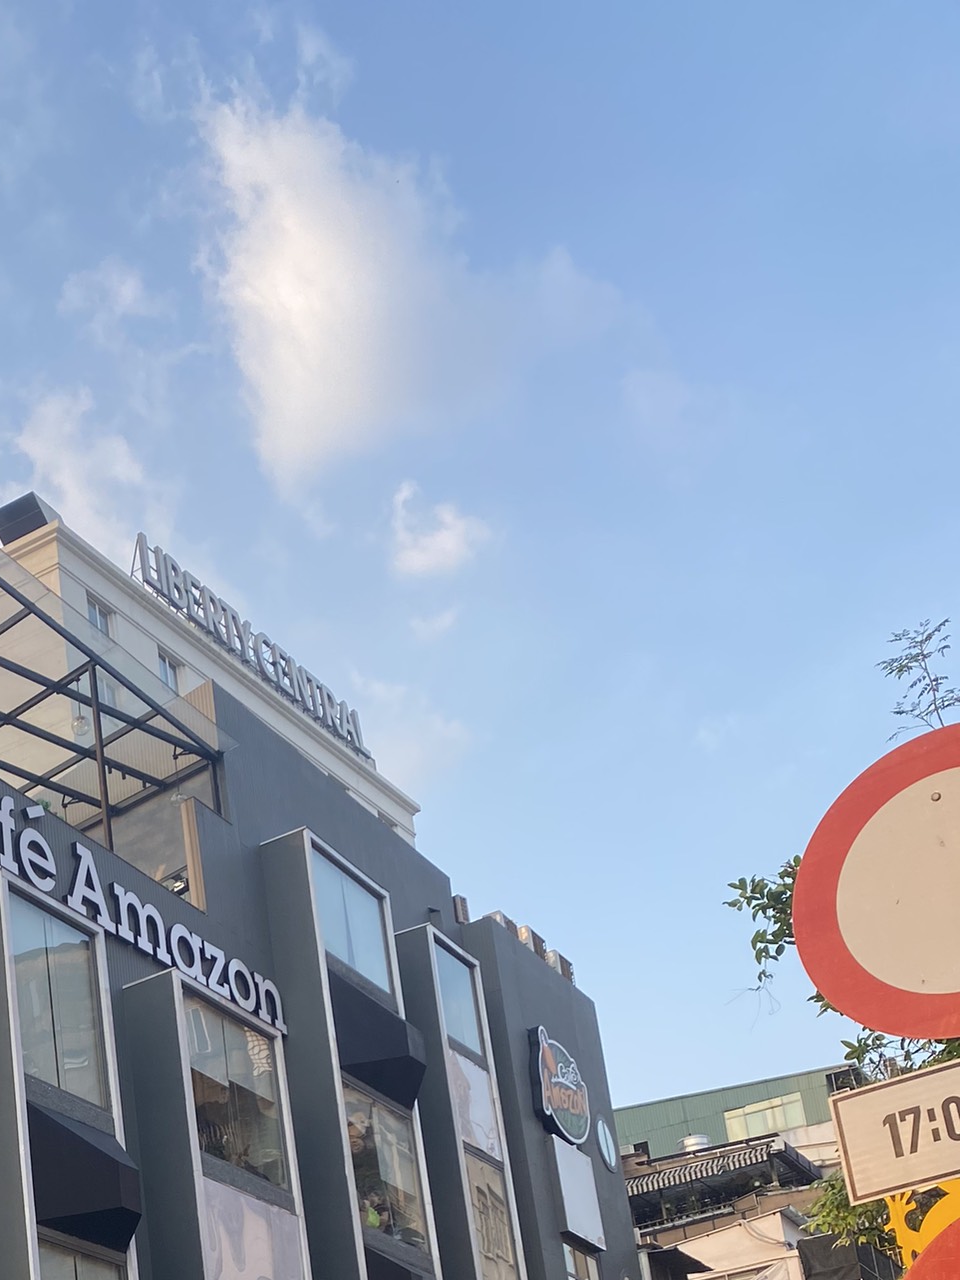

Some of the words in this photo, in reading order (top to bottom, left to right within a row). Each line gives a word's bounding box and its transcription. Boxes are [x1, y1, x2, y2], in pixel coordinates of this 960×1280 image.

[137, 531, 252, 664] LIBERTY
[253, 631, 372, 759] CENTRAL
[65, 841, 289, 1036] Amazon
